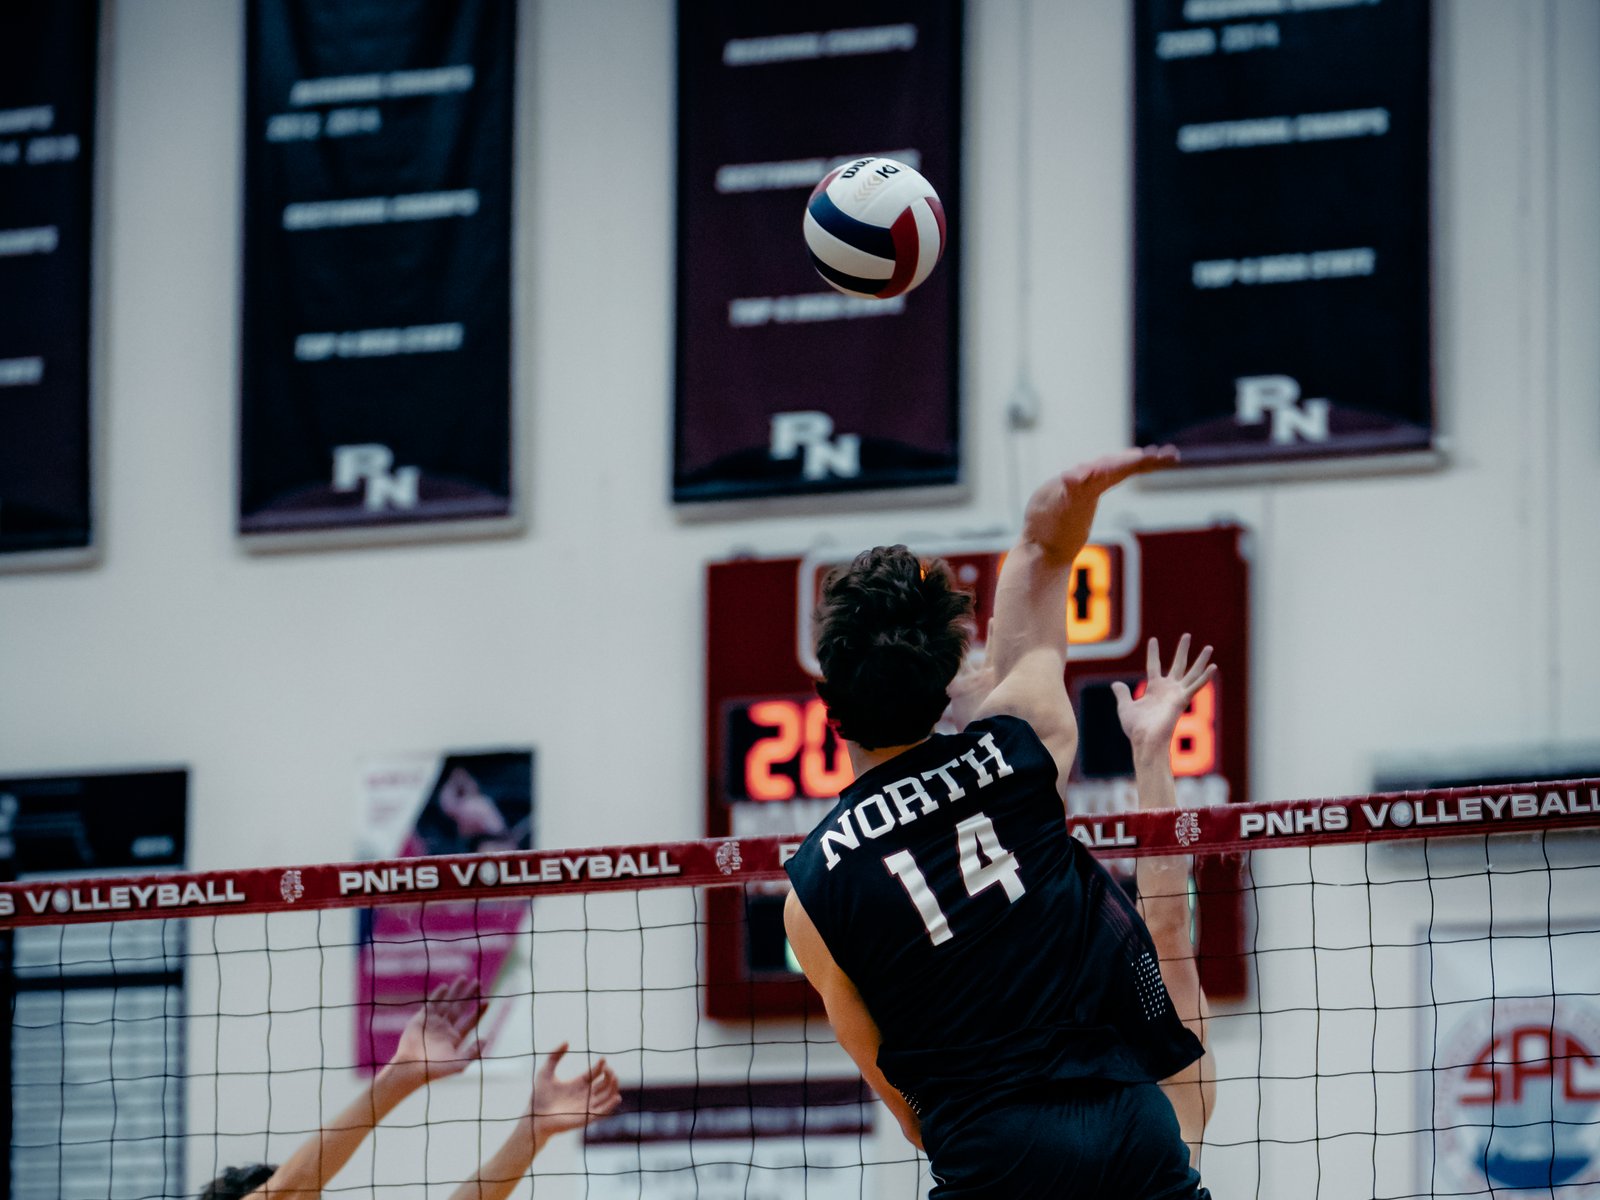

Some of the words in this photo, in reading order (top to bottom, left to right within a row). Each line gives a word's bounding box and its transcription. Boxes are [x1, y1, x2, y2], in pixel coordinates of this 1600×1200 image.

[819, 732, 1014, 871] NORTH
[1239, 805, 1349, 839] PNHS
[25, 878, 246, 914] VOLLEYBALL
[339, 866, 439, 896] PNHS
[450, 850, 681, 887] VOLLEYBALL
[882, 812, 1027, 947] 14
